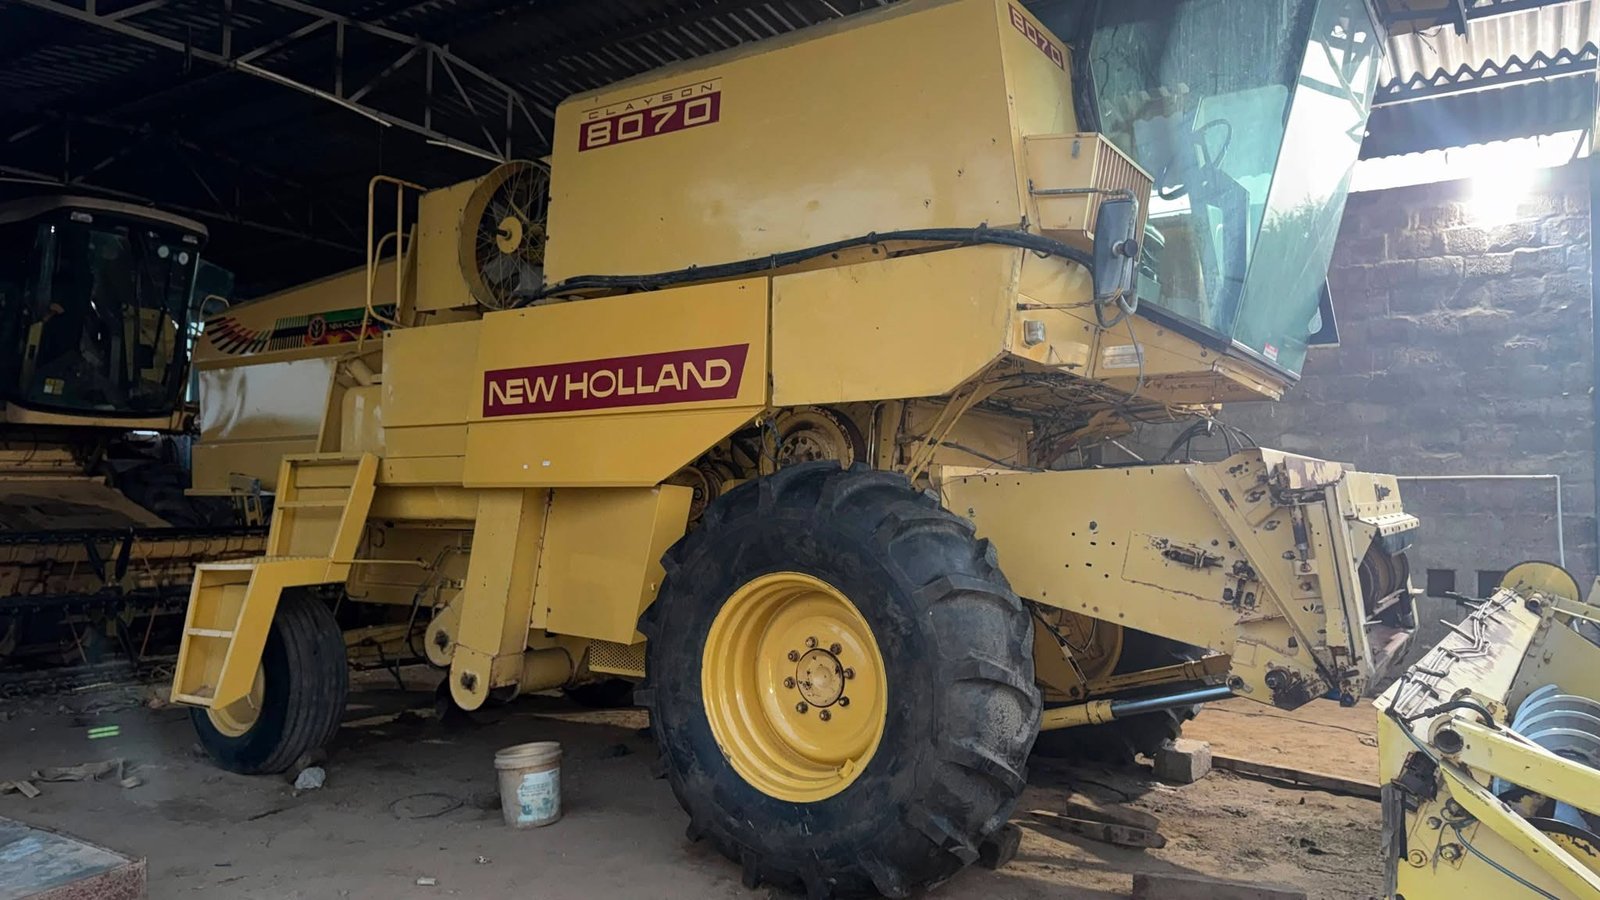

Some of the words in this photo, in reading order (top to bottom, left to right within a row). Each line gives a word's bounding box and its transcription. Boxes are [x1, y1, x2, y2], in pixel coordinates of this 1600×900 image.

[1011, 7, 1063, 69] 8070
[586, 96, 712, 147] 8070
[588, 83, 713, 120] CLAYSON
[488, 375, 558, 406] NEW
[565, 358, 732, 400] HOLLAND
